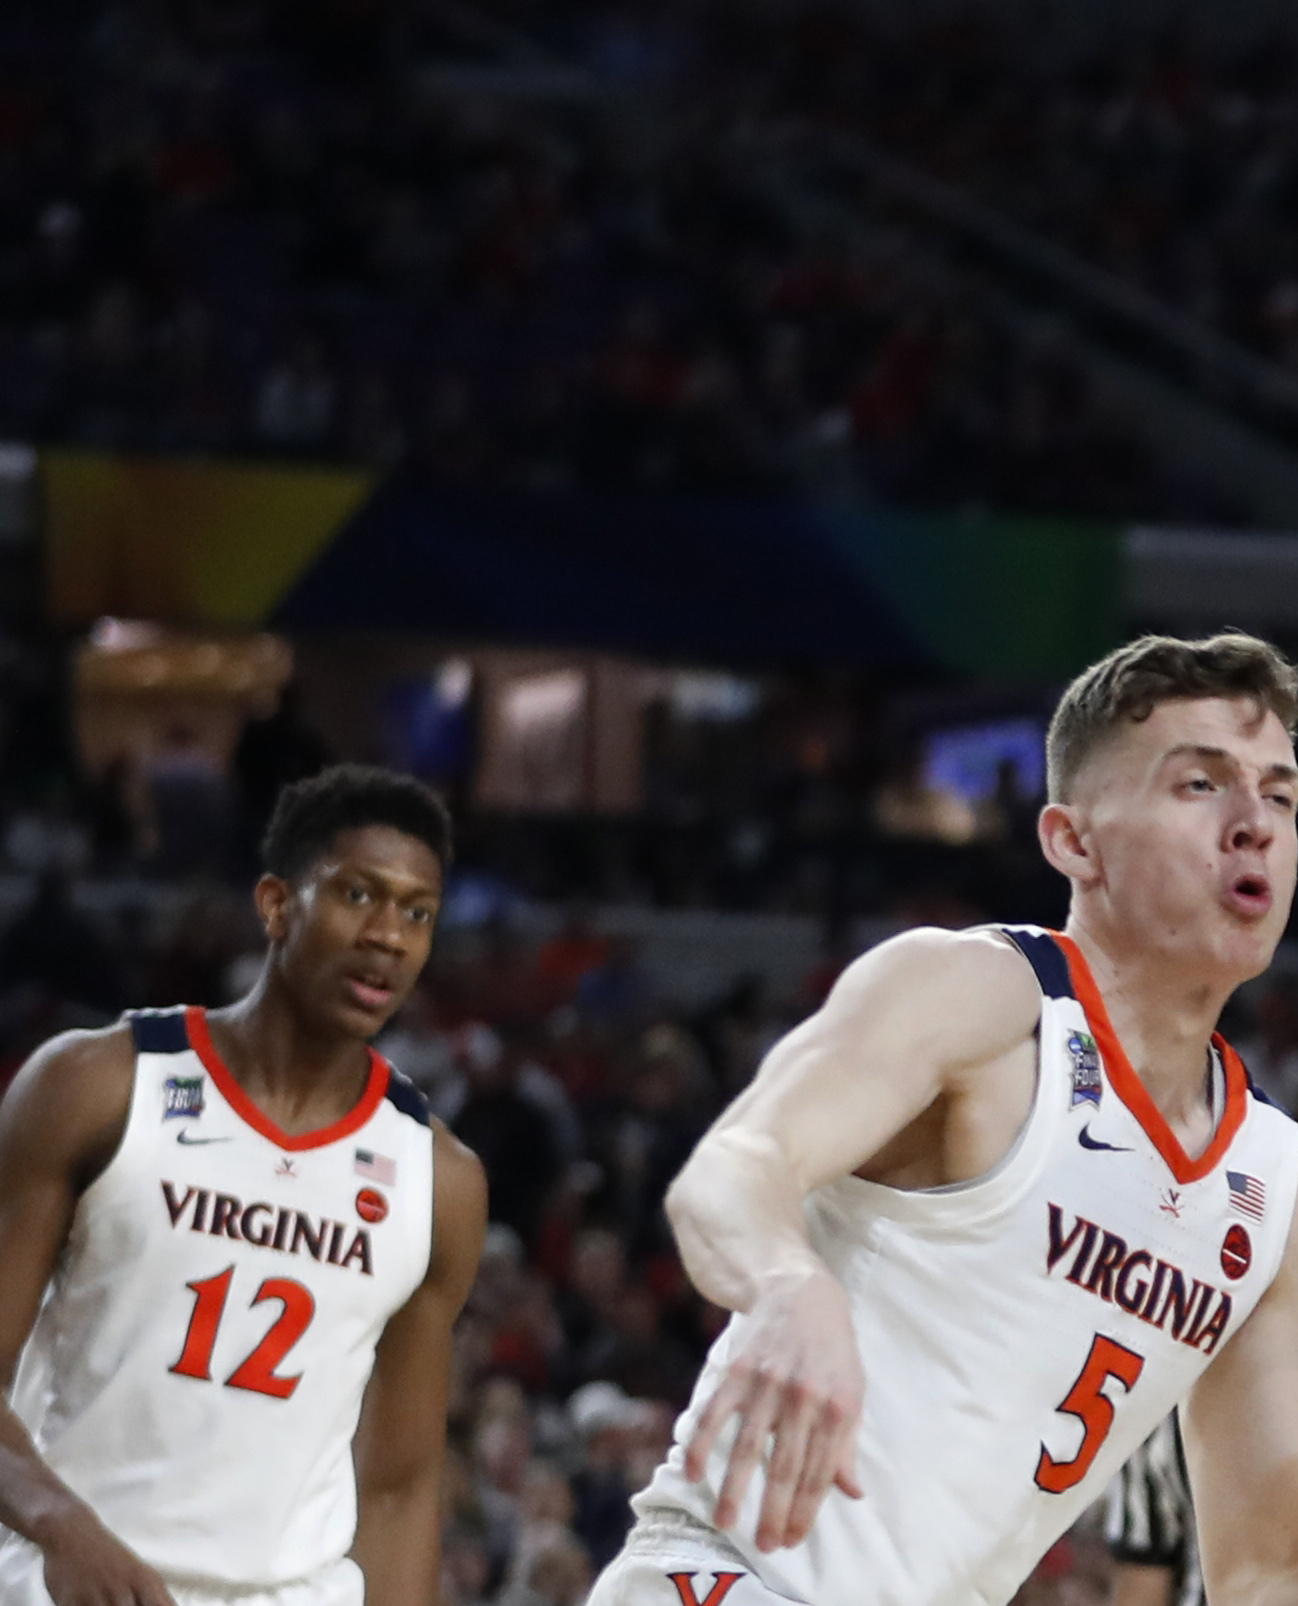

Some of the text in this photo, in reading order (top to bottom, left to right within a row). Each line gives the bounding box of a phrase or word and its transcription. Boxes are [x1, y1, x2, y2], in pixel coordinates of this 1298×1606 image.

[160, 1179, 375, 1277] VIRGINIA
[1047, 1201, 1233, 1356] VIRGINIA
[167, 1264, 317, 1401] 12
[1034, 1332, 1146, 1494] 5
